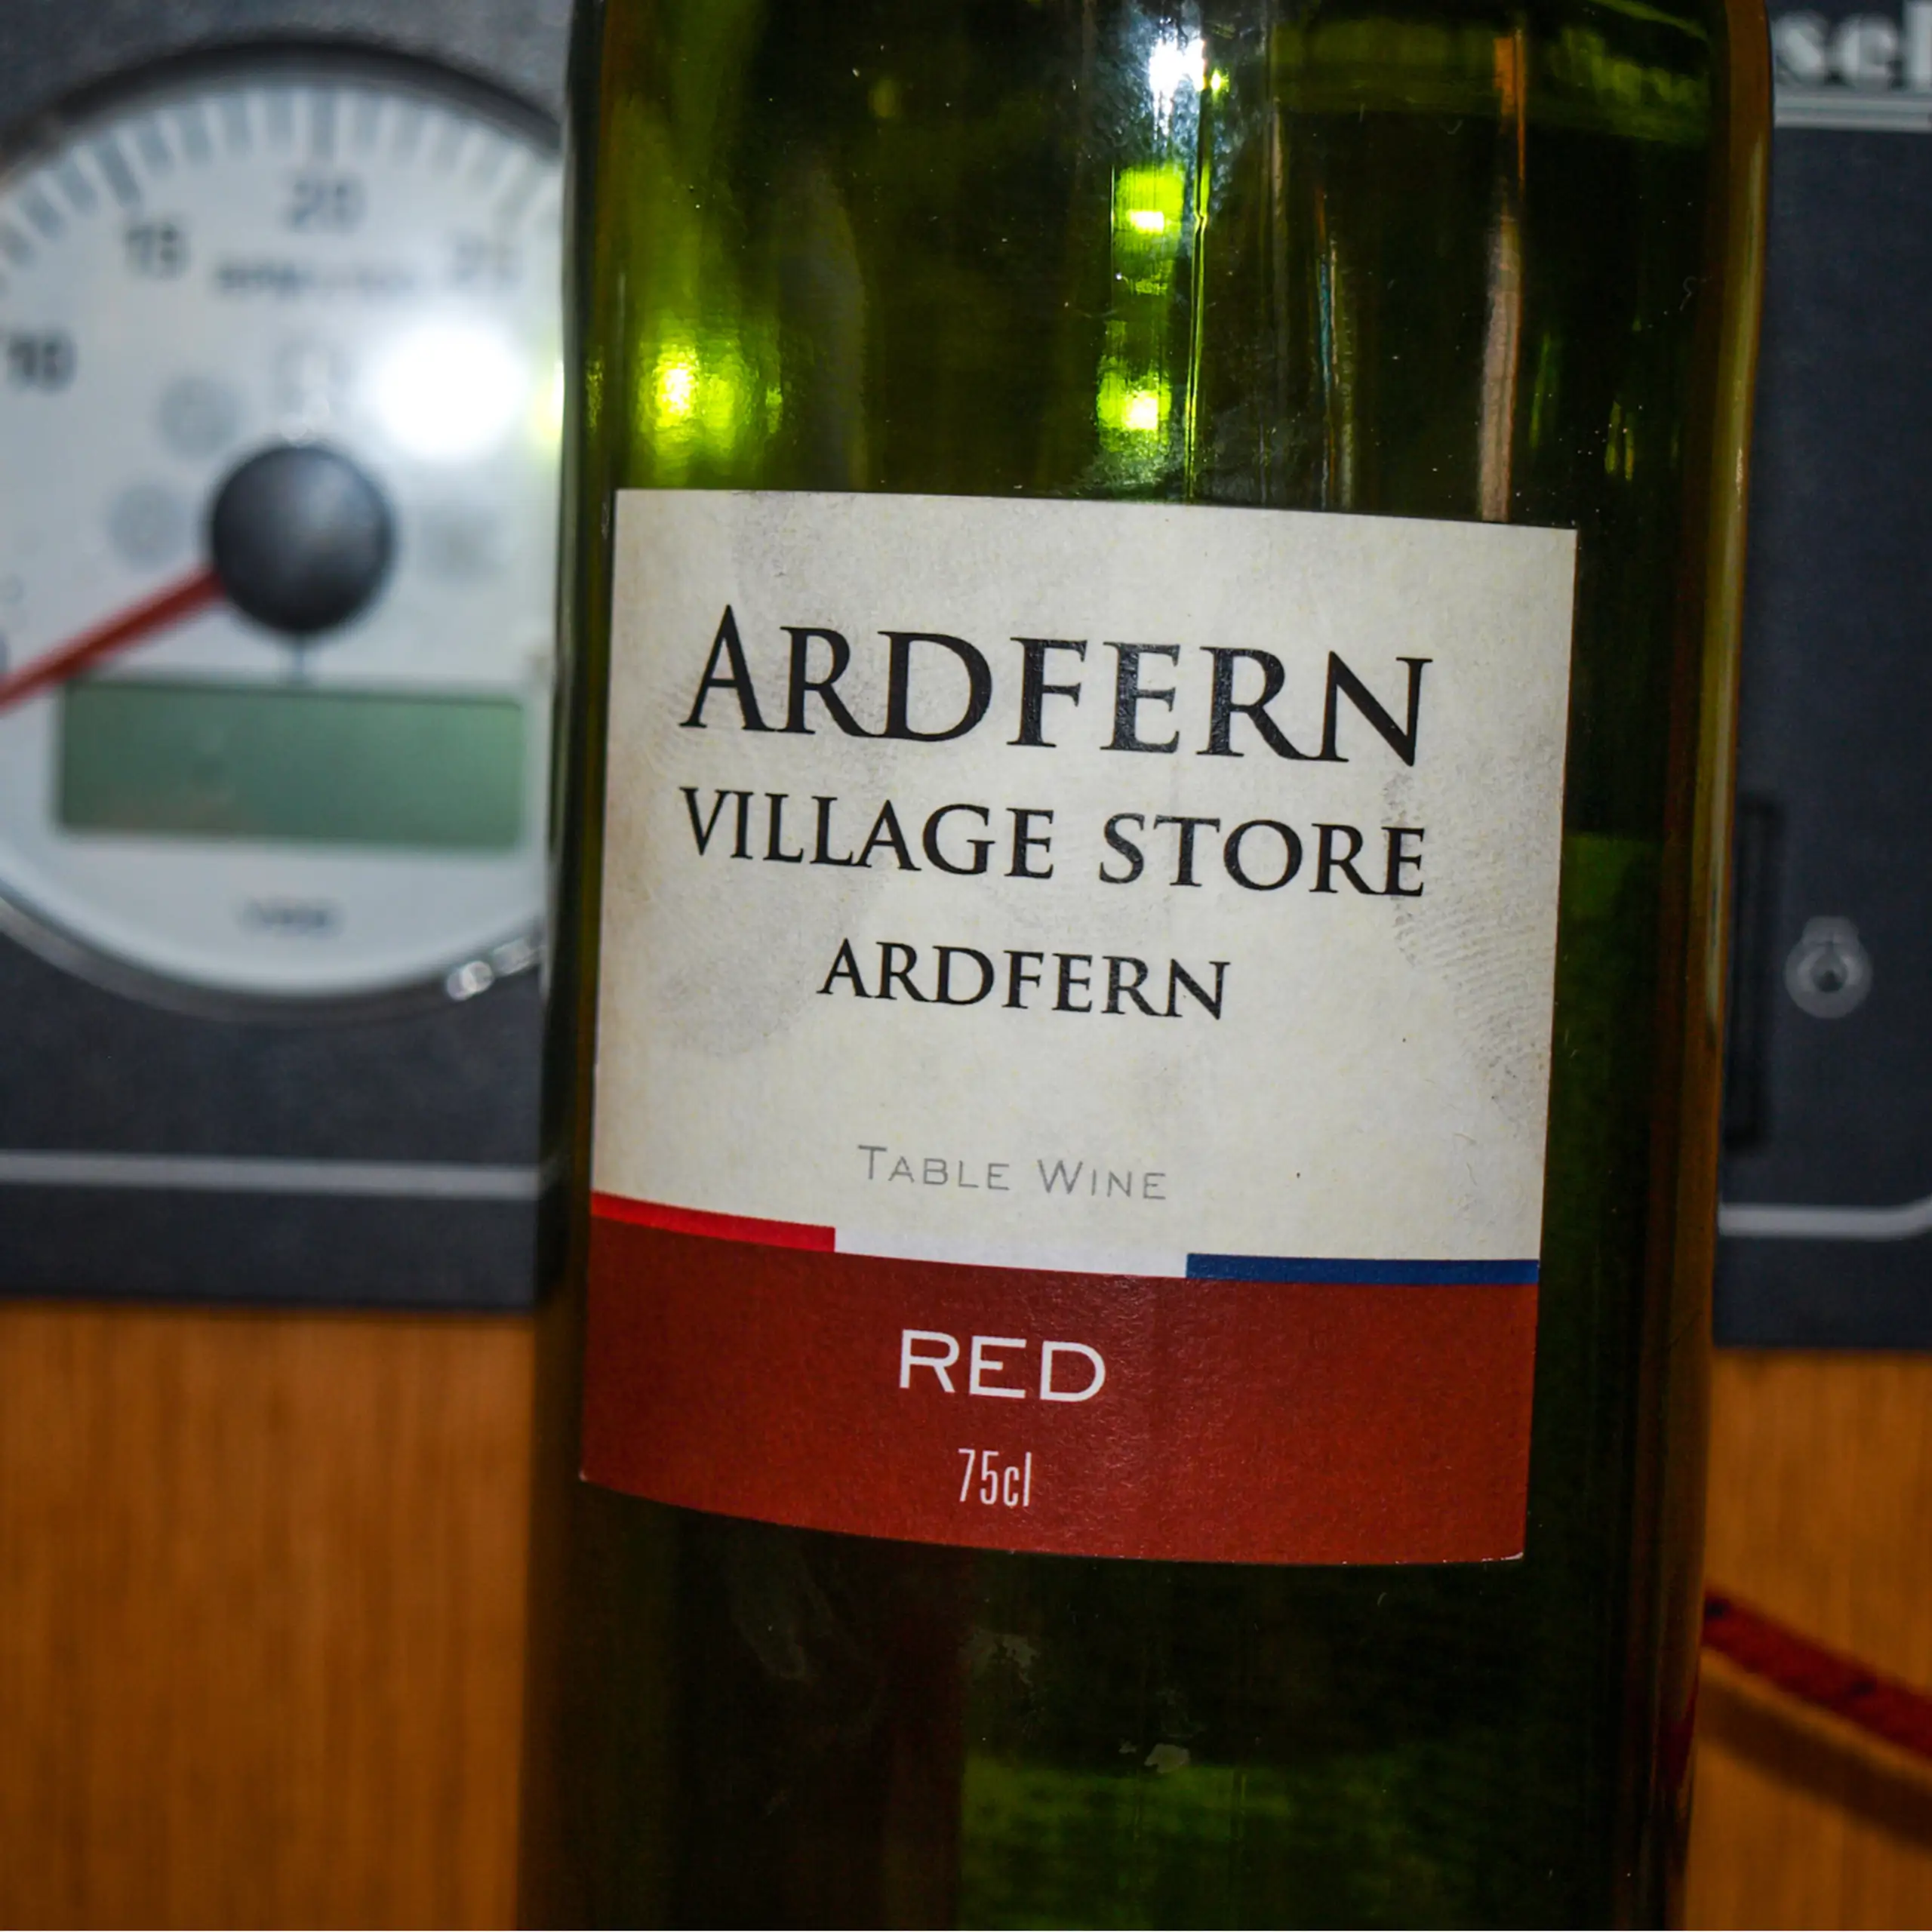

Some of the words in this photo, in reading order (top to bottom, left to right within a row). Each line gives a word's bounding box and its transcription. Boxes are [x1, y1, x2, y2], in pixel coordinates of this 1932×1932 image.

[678, 605, 1433, 767] ARDFERN
[679, 786, 1055, 879] VILLAGE
[1099, 812, 1425, 897] STORE
[816, 938, 1231, 1020] ARDFERN
[858, 1145, 1010, 1190] TABLE
[1037, 1159, 1166, 1200] WINE
[900, 1329, 1106, 1402] RED
[958, 1448, 1032, 1507] 75cl
